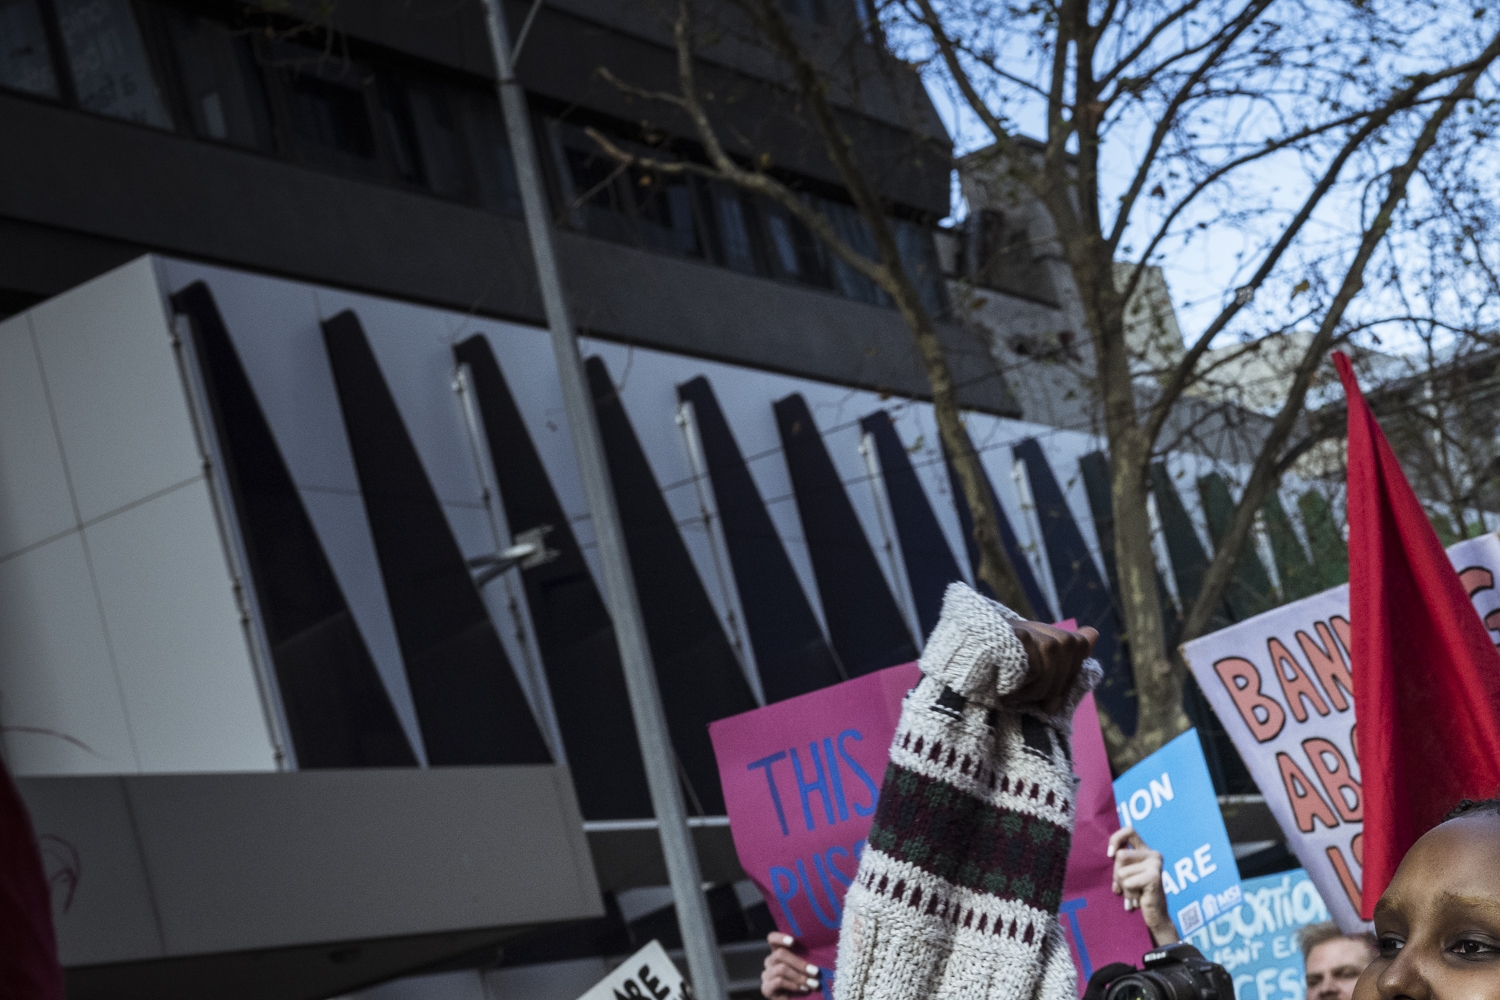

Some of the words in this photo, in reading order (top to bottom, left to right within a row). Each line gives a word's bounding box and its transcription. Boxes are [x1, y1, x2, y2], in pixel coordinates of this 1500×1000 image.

[747, 729, 880, 835] THIS
[1117, 773, 1174, 827] ION
[769, 844, 864, 936] PUS
